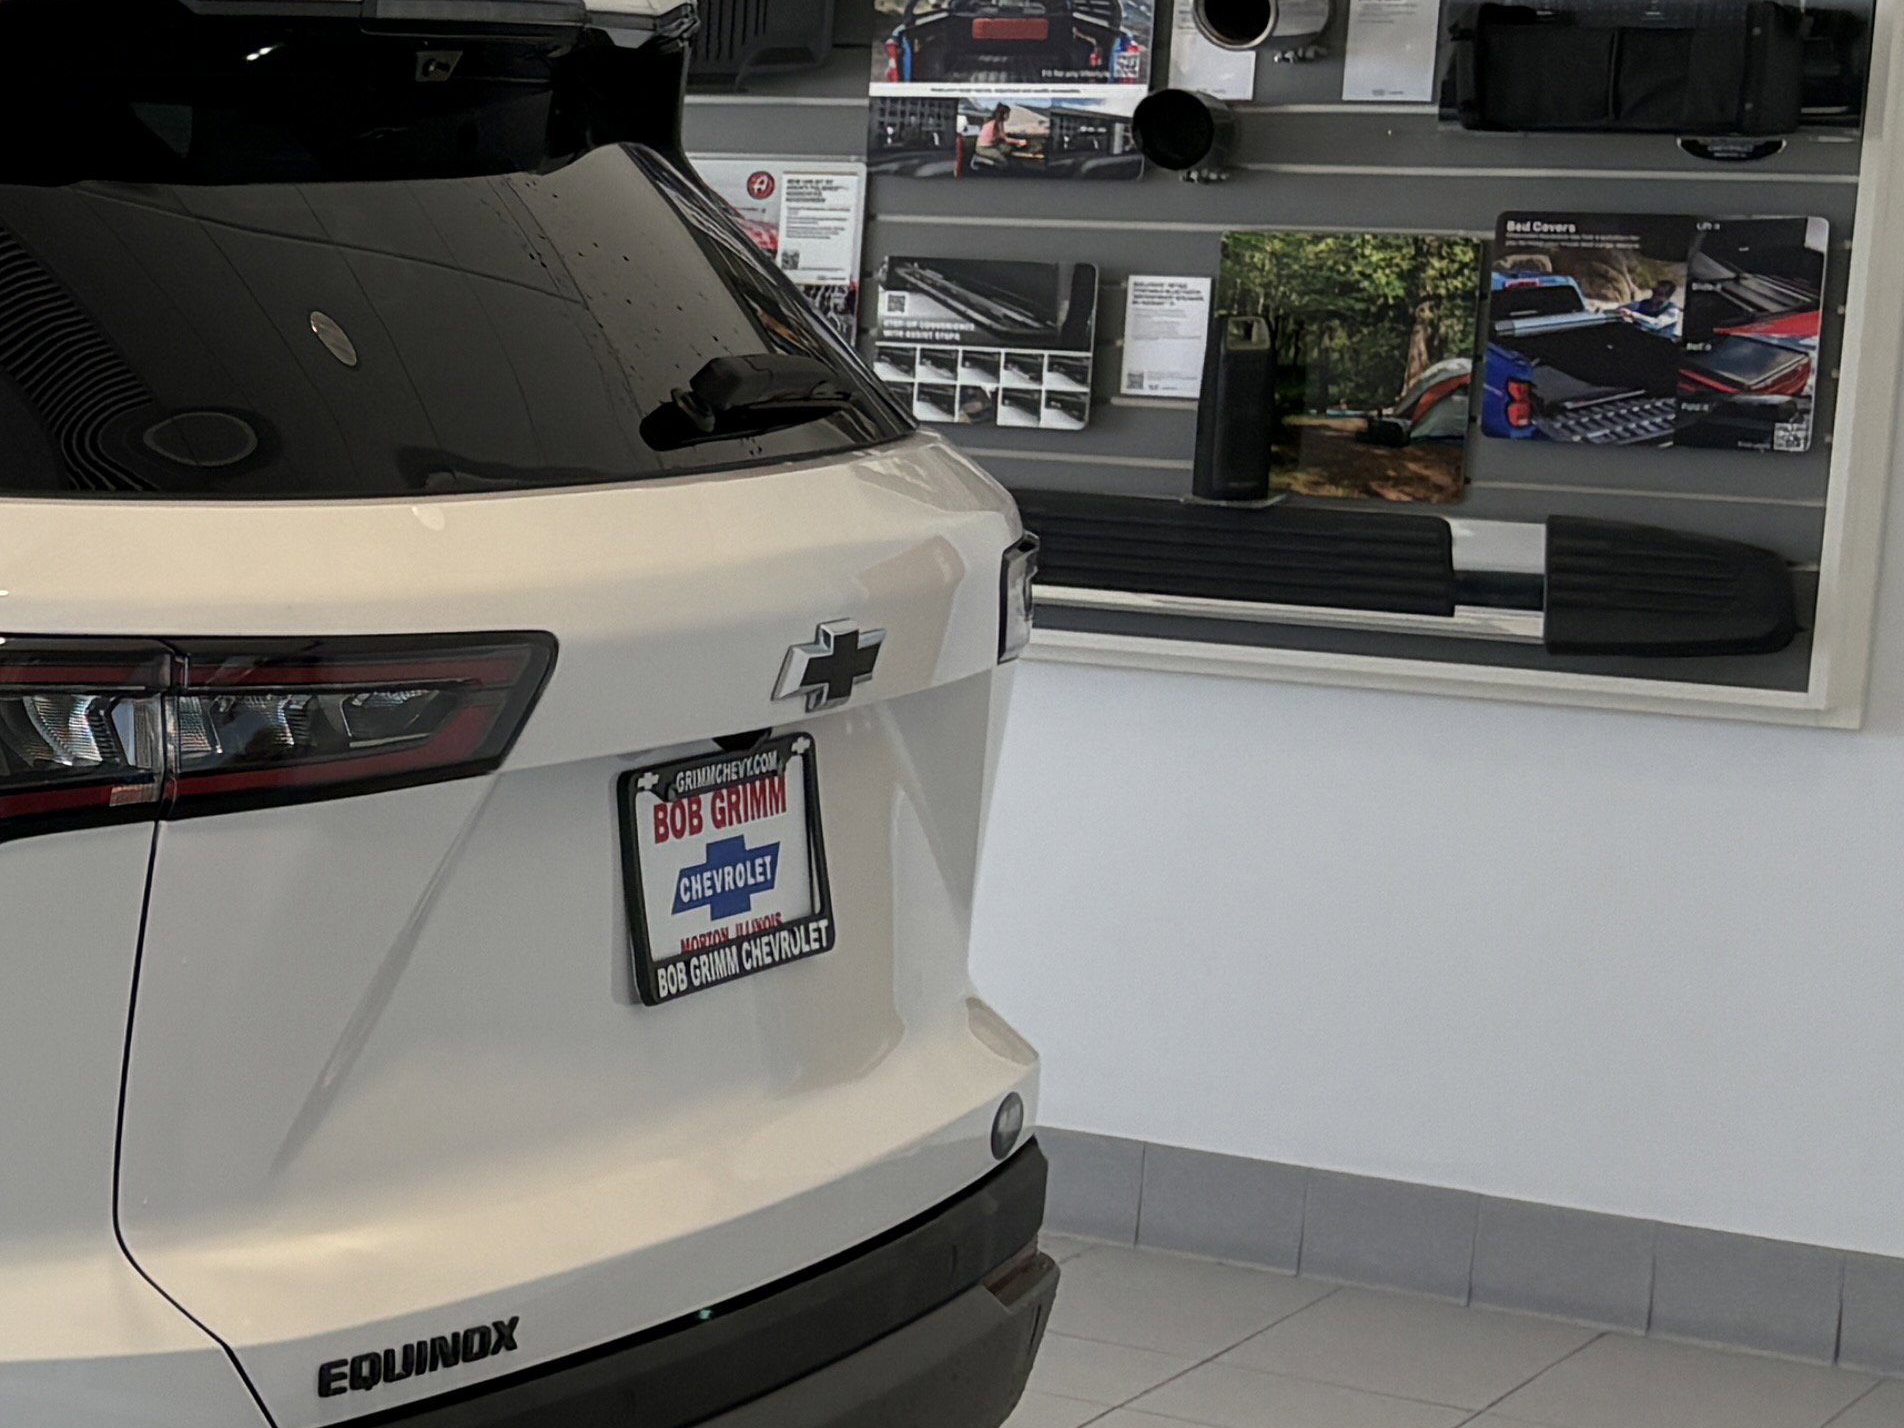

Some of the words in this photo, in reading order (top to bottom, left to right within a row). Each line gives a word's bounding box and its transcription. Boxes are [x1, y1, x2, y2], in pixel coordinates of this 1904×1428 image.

[1507, 221, 1531, 232] Bed
[1533, 221, 1576, 233] Covers
[676, 750, 778, 793] GRIMMCHEVY.COM
[653, 796, 703, 844] BOB
[711, 776, 787, 829] GRIMM
[680, 855, 772, 903] CHEVROLET
[656, 961, 688, 999] BOB
[690, 945, 739, 988] GRIMM
[742, 919, 829, 971] CHEVROLET
[318, 1316, 520, 1398] EQUINOX
